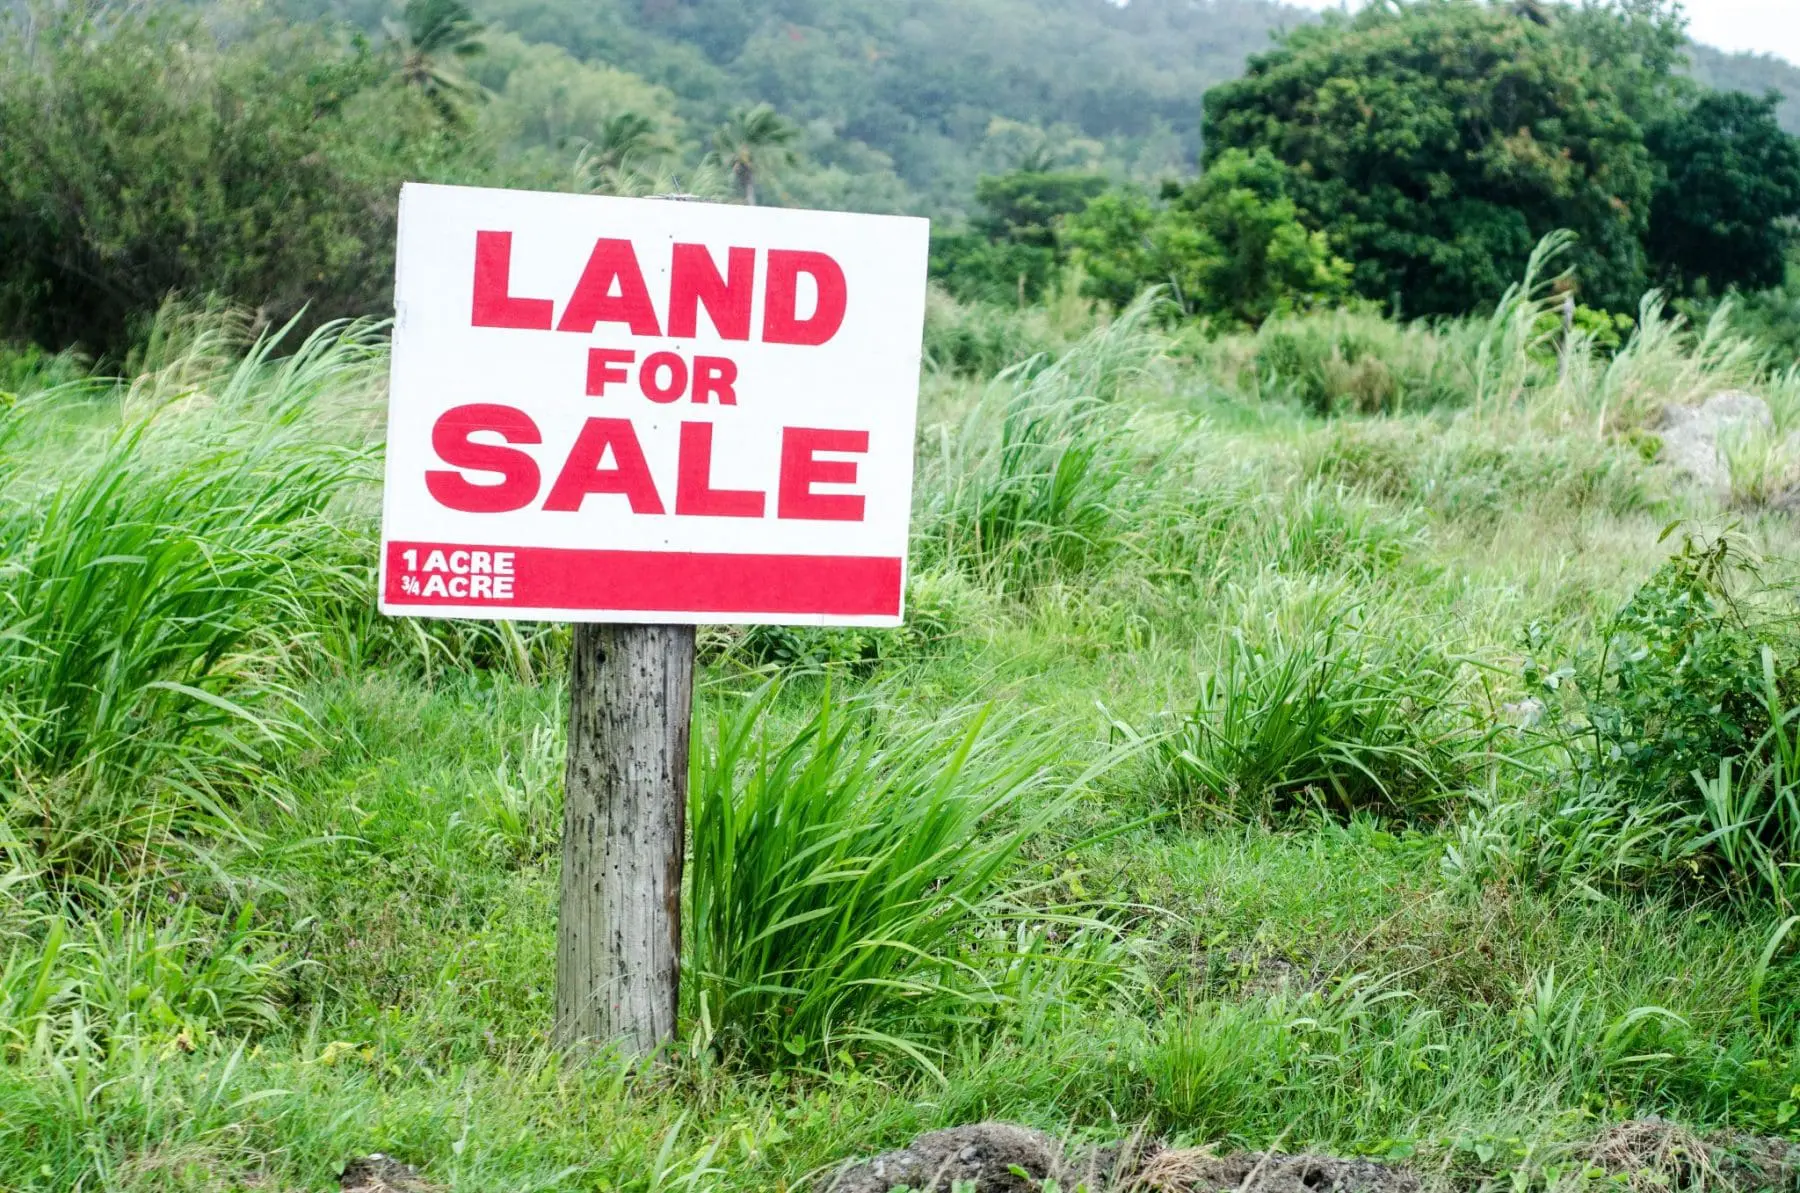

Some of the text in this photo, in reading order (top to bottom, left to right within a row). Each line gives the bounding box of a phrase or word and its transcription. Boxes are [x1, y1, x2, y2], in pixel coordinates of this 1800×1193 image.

[471, 231, 847, 346] LAND
[586, 347, 737, 405] FOR
[425, 403, 869, 521] SALE
[402, 549, 515, 575] 1 ACRE
[421, 575, 515, 599] ACRE
